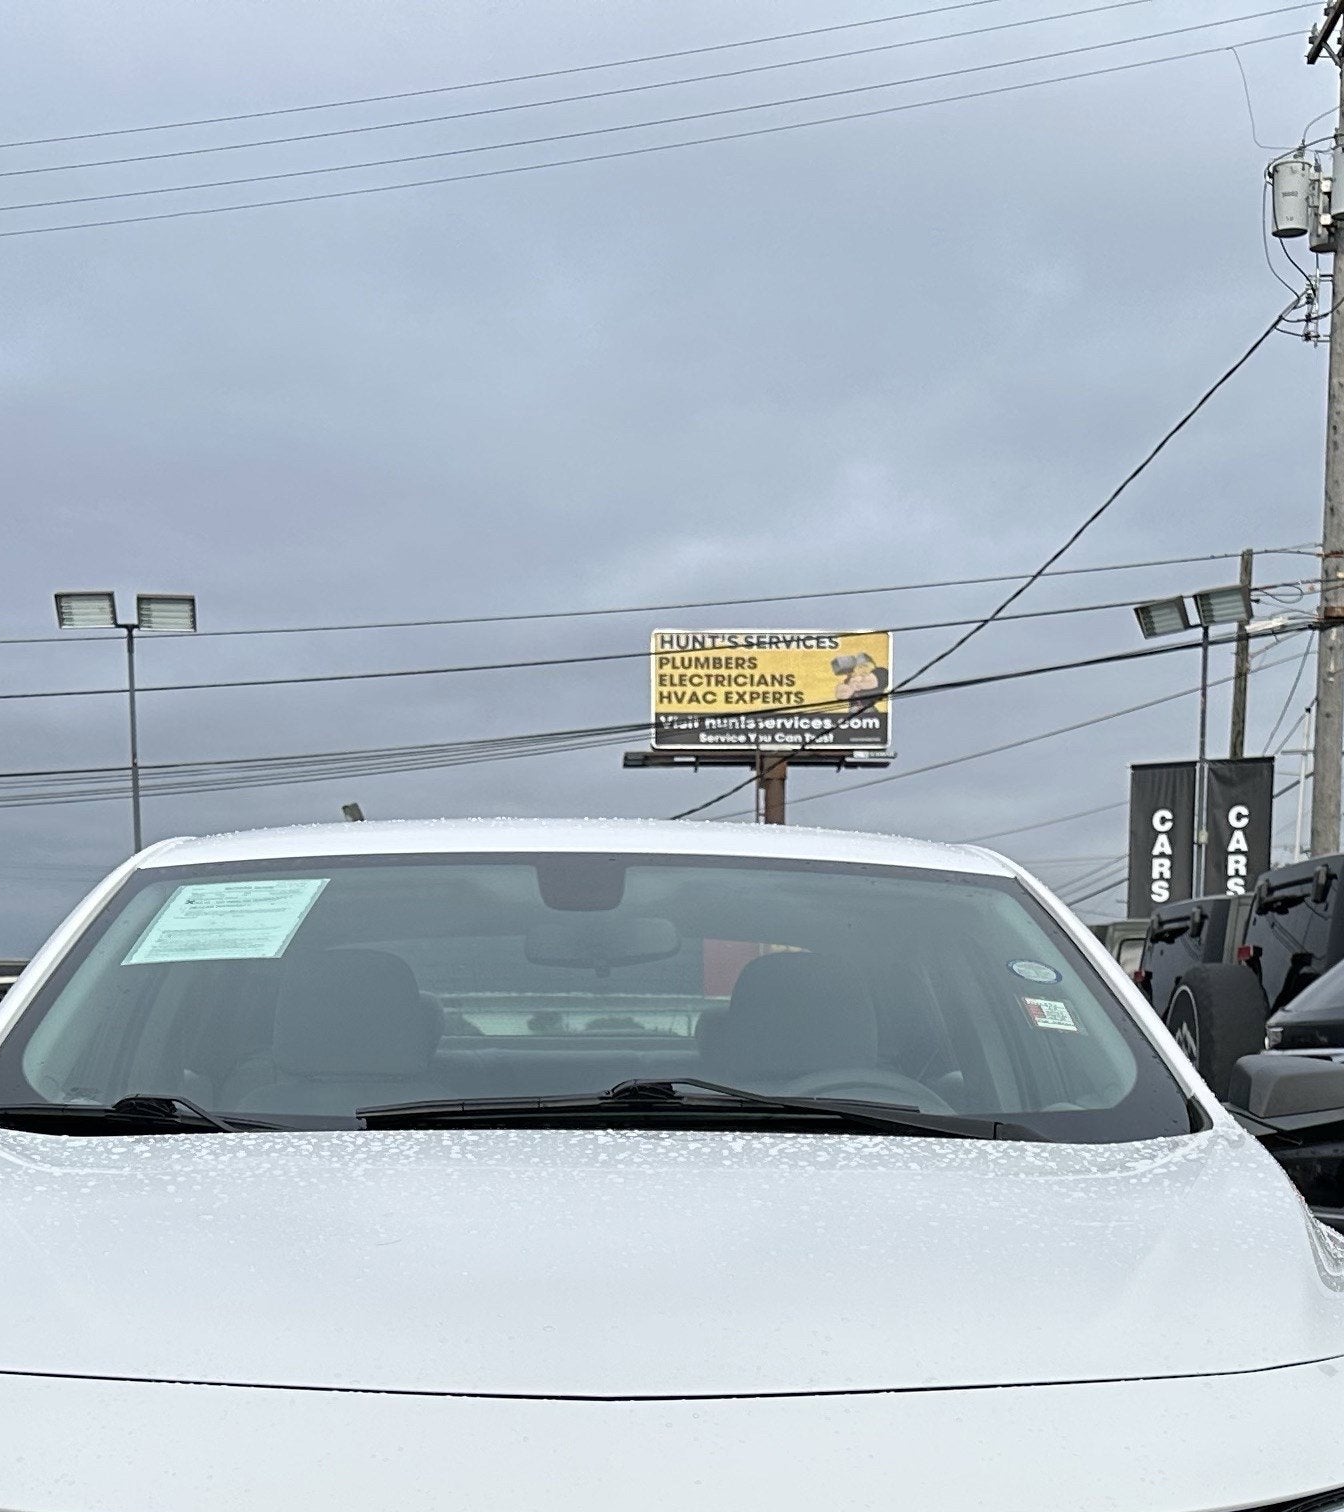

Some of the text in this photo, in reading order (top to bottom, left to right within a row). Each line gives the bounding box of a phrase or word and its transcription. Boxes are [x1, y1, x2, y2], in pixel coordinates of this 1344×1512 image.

[660, 634, 839, 649] HUNT'S SERVICES
[658, 656, 757, 670] PLUMBERS
[658, 673, 796, 688] ELECTRICIANS
[658, 690, 805, 705] HVAC EXPERTS
[699, 732, 746, 743] Service
[774, 732, 803, 743] Can
[1150, 808, 1174, 903] CARS
[1225, 805, 1250, 896] CARS
